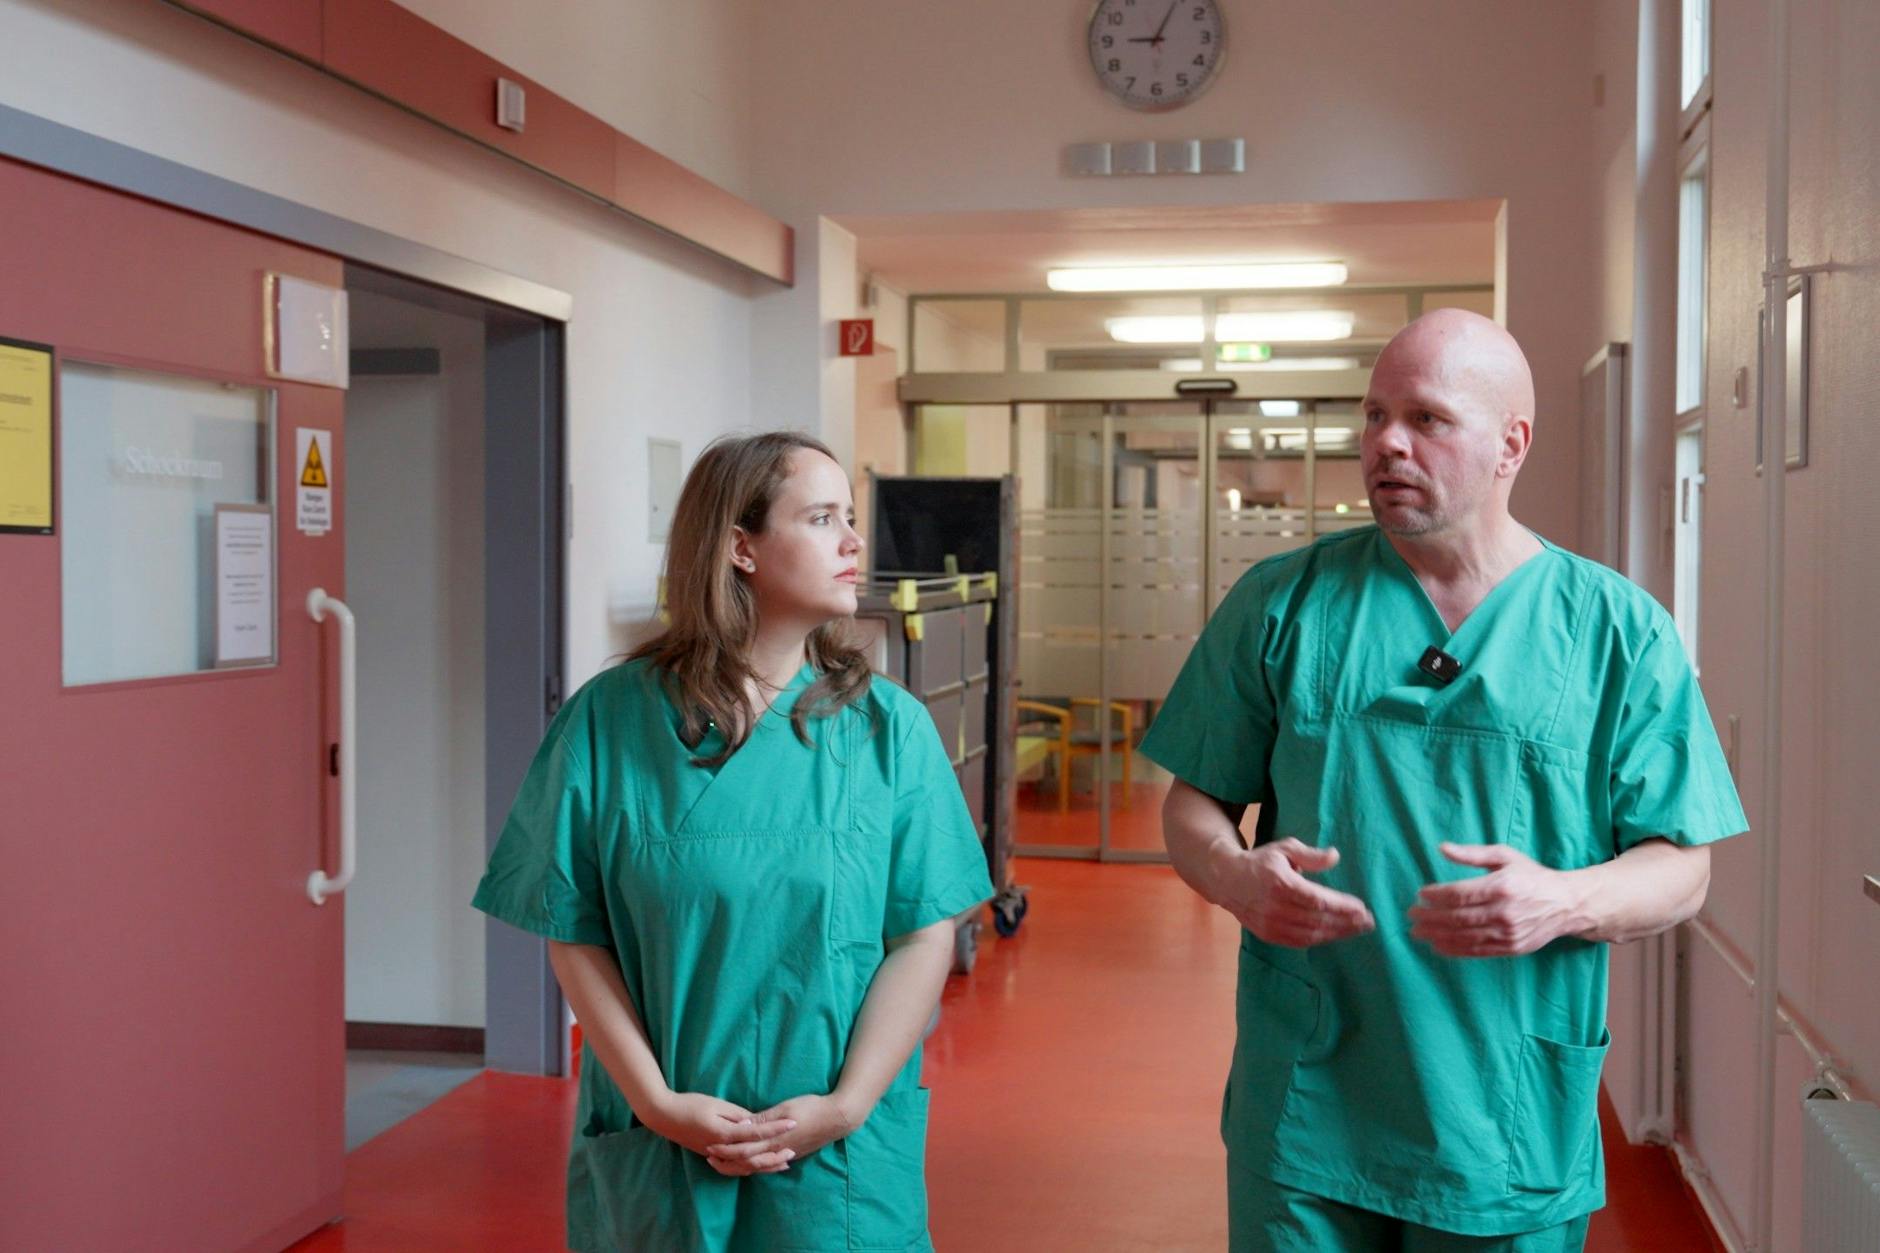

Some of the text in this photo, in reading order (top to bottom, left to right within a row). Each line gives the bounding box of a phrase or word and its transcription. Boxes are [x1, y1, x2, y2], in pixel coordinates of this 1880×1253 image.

[1107, 10, 1123, 26] 10
[1192, 7, 1205, 21] 2
[1101, 35, 1114, 49] 9
[1200, 30, 1211, 45] 3
[1107, 58, 1121, 72] 8
[1192, 53, 1205, 66] 4
[1124, 76, 1137, 90] 7
[1175, 72, 1189, 87] 5
[1150, 82, 1163, 96] 6
